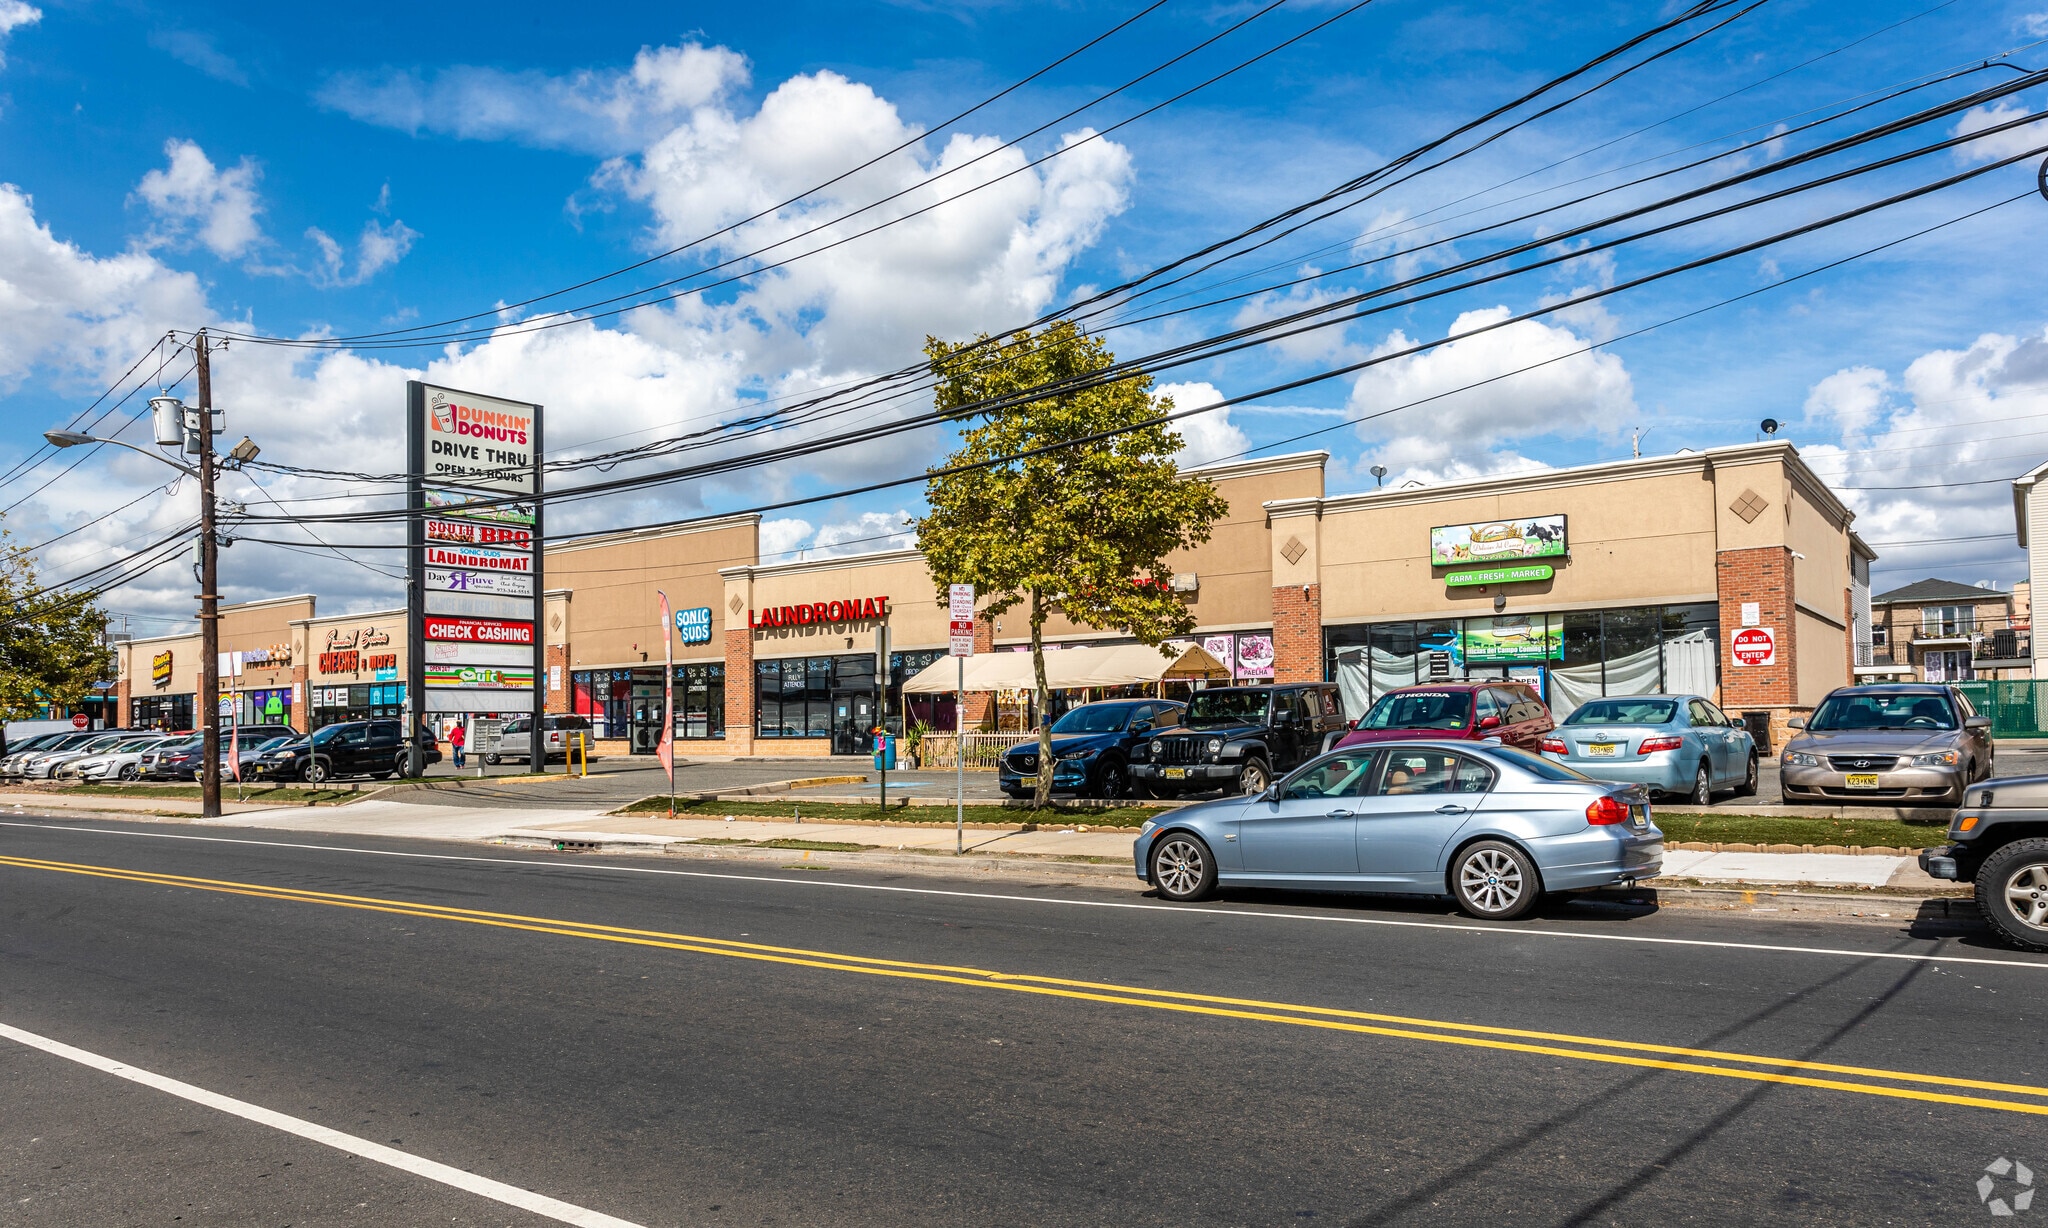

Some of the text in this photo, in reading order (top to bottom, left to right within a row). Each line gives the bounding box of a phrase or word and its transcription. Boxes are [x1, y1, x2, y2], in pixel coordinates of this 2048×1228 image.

[459, 405, 530, 432] DUNKIN'
[458, 421, 527, 445] DONUTS
[432, 440, 526, 467] DRIVE THRU
[435, 462, 465, 475] OPEN
[487, 470, 523, 483] HOURS
[429, 521, 530, 549] SOUTH BBQ
[429, 549, 529, 571] LAUNDROMAT
[460, 548, 501, 558] SONIC SUDS
[428, 572, 448, 583] Day
[1450, 569, 1546, 583] FARM FRESH MARKET
[676, 608, 709, 627] SONIC
[748, 596, 889, 629] LAUNDROMAT
[429, 624, 529, 641] CHECK CASHING
[682, 624, 709, 641] SUDS
[1519, 645, 1541, 653] Coming
[1741, 651, 1765, 659] ENTER
[153, 652, 170, 667] Snack
[319, 650, 359, 672] CHECKS
[369, 654, 395, 669] more
[153, 664, 170, 679] Mania
[905, 668, 919, 676] DROP
